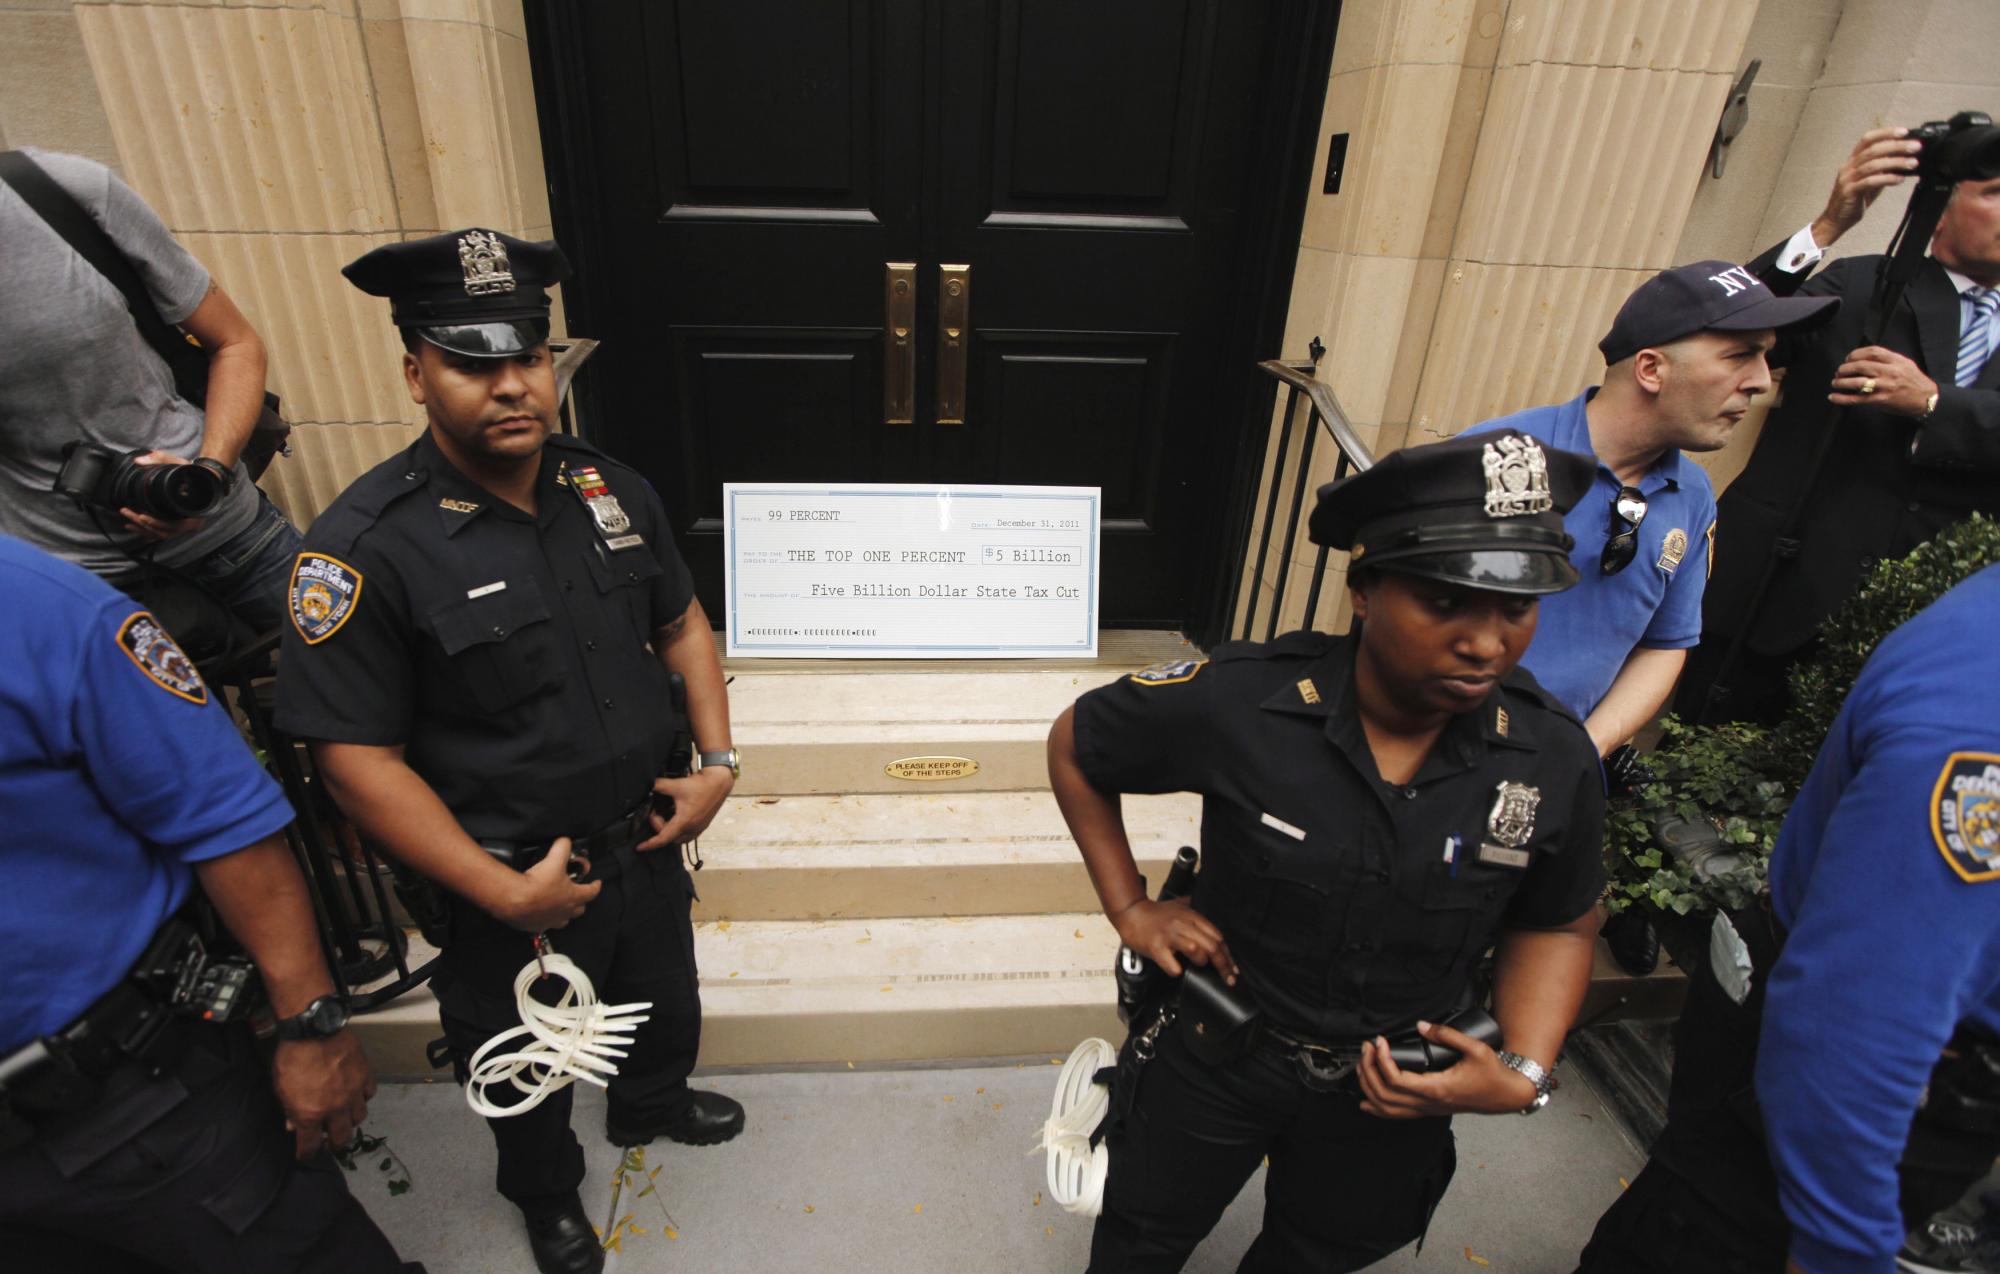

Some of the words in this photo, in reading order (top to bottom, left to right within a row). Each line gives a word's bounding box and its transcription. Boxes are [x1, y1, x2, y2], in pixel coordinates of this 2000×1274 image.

[768, 510, 782, 521] 99
[790, 510, 841, 521] PERCENT
[997, 519, 1036, 528] December
[1040, 520, 1055, 529] 31,
[1060, 520, 1080, 528] 2011
[787, 550, 816, 562] THE
[825, 550, 853, 562] TOP
[863, 550, 891, 562] ONE
[901, 551, 966, 563] PERCENT
[1013, 549, 1072, 563] Billion
[310, 558, 344, 577] POLICE
[297, 566, 354, 594] DEPARTMENT
[811, 583, 845, 597] Five
[853, 584, 911, 598] Billion
[919, 584, 968, 598] Dollar
[976, 585, 1017, 598] State
[1024, 586, 1049, 598] Tax
[1056, 586, 1080, 598] Cut
